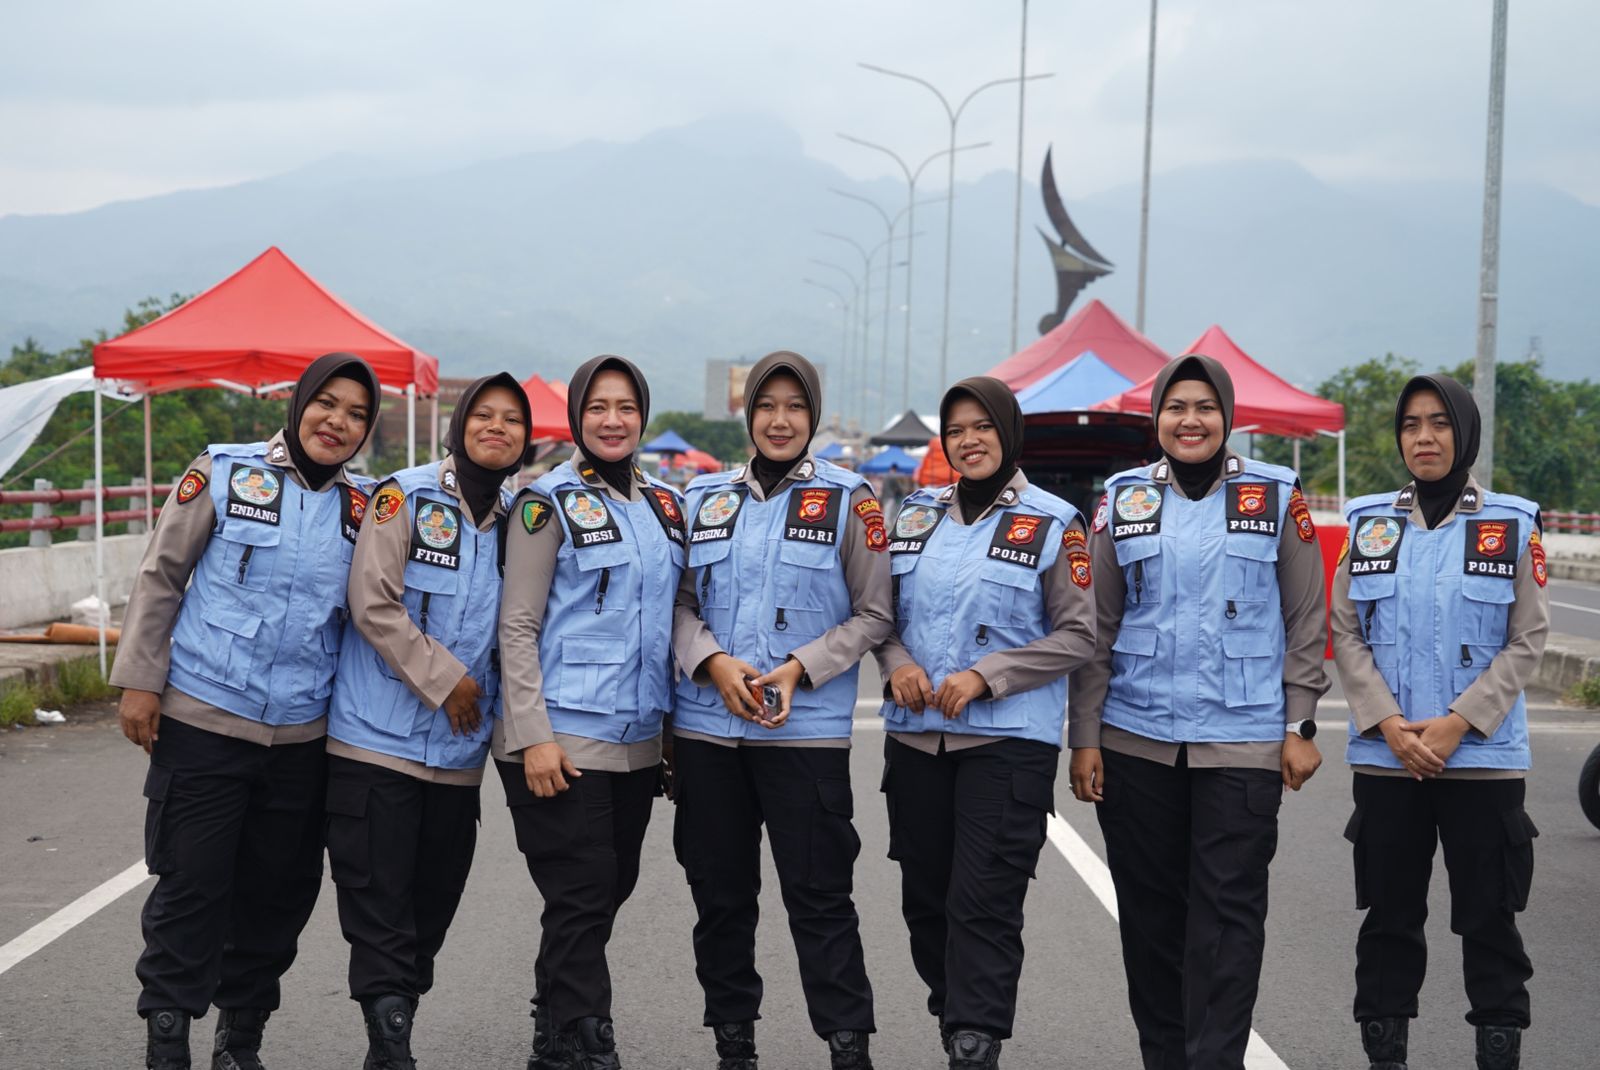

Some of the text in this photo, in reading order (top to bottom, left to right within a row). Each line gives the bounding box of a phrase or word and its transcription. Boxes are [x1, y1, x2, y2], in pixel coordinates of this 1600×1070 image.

[229, 503, 278, 523] ENDANG
[1115, 523, 1156, 537] ENNY
[1230, 519, 1275, 534] POLRI
[582, 530, 615, 544] DESI
[691, 528, 728, 543] REGINA
[788, 527, 834, 543] POLRI
[416, 548, 456, 567] FITRI
[991, 547, 1036, 566] POLRI
[1352, 560, 1390, 573] DAYU
[1468, 561, 1514, 575] POLRI
